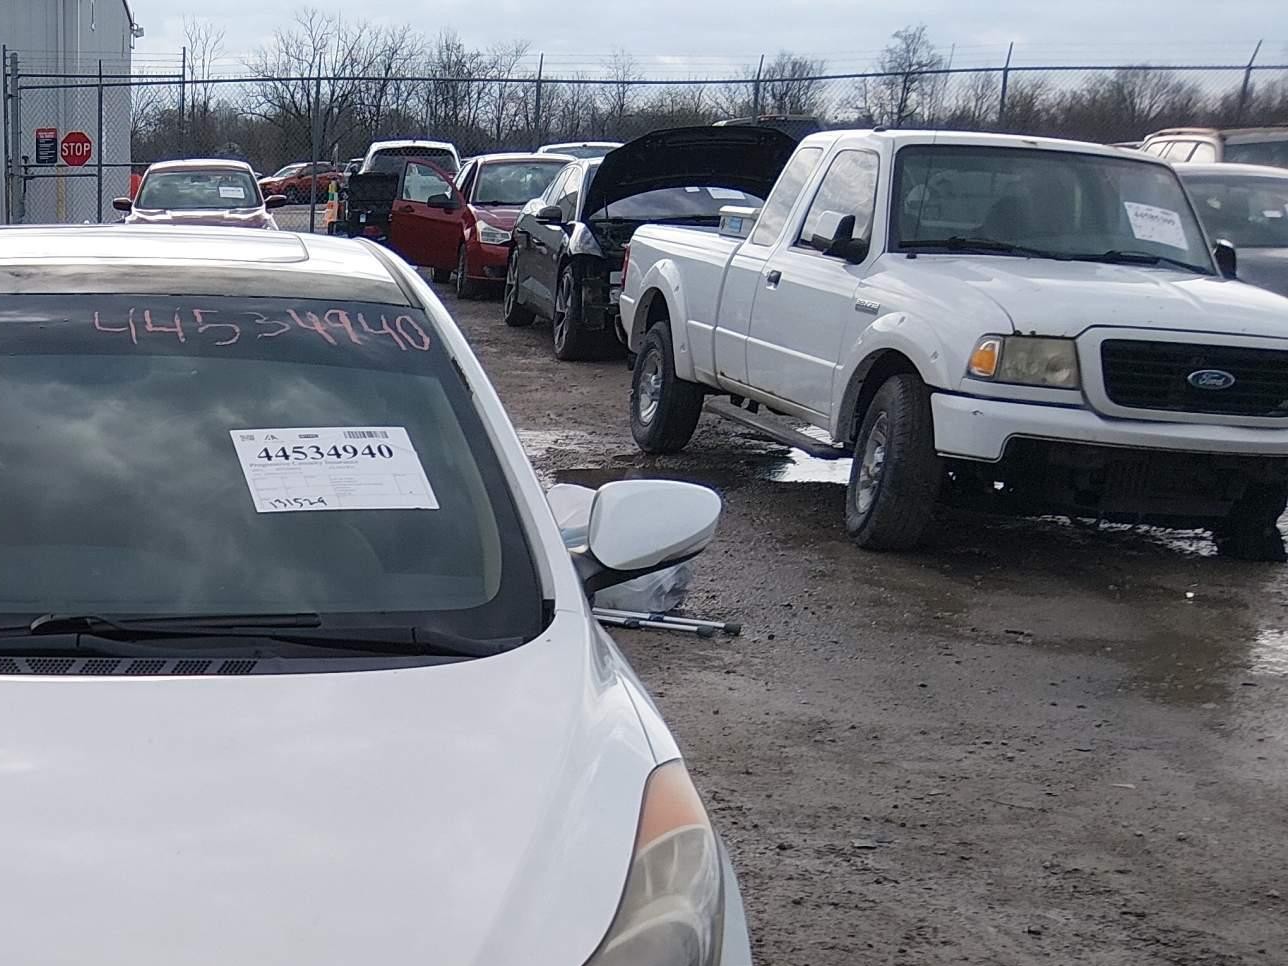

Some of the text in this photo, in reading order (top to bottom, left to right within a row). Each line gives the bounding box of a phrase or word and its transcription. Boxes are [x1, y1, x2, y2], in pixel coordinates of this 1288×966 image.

[62, 142, 90, 156] STOP
[94, 308, 430, 350] 44534940
[257, 443, 394, 462] 44534940
